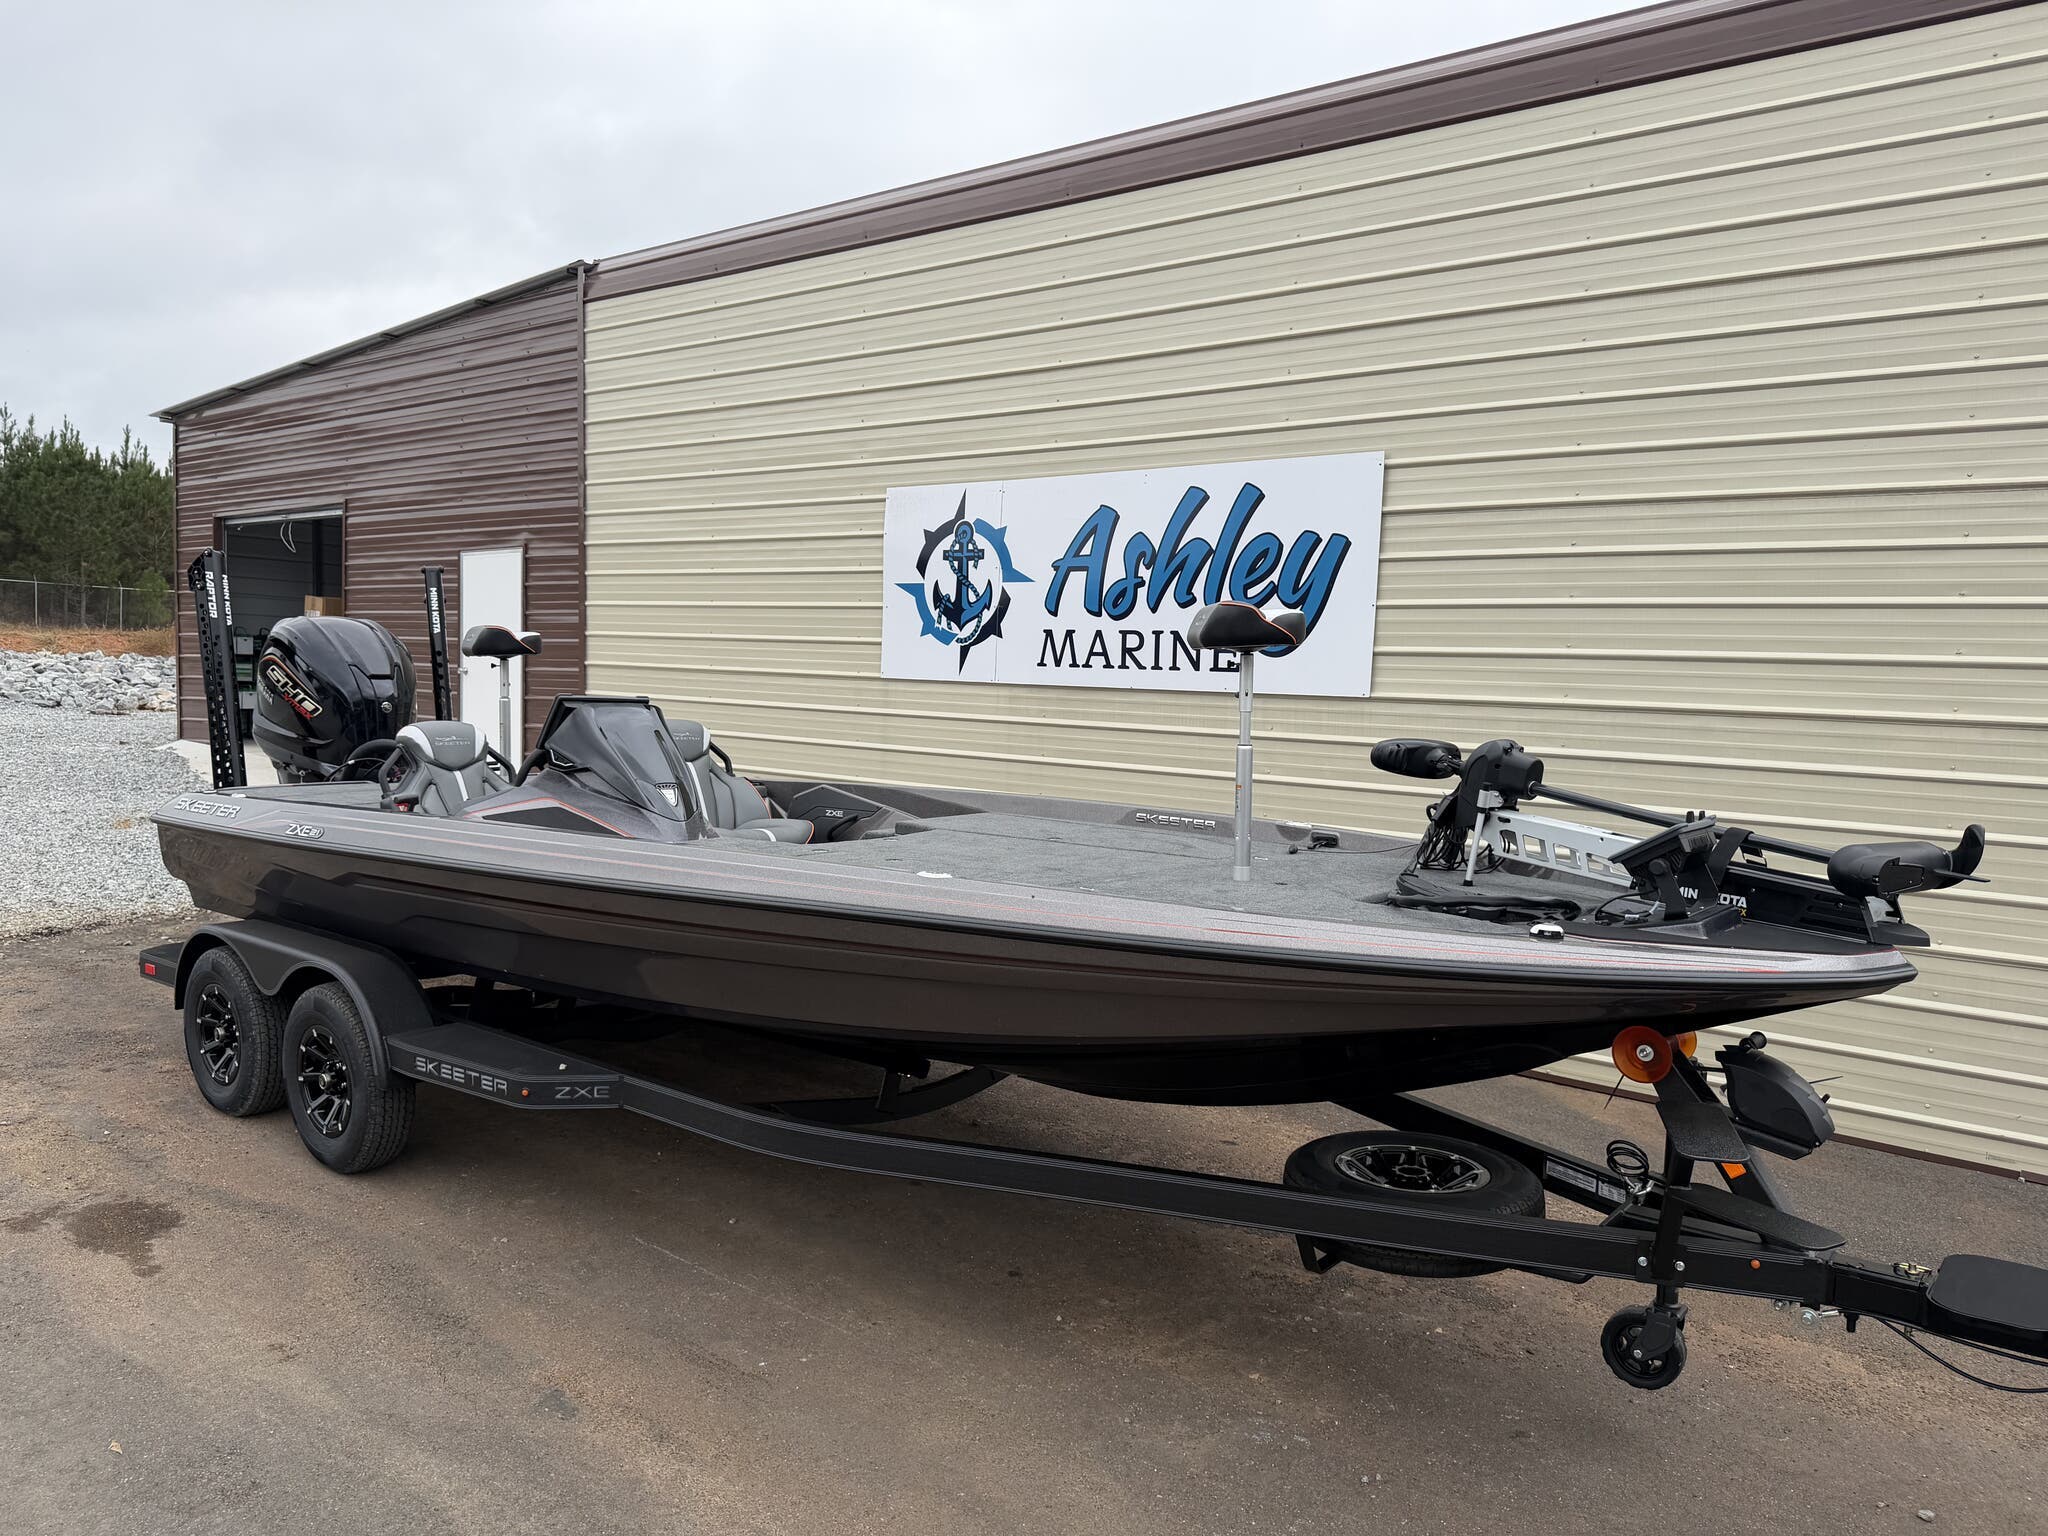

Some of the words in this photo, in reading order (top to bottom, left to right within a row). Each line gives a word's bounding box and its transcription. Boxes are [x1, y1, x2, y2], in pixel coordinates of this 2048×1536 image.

[1044, 482, 1352, 658] Ashley
[205, 571, 218, 618] RAPTOR
[222, 574, 230, 600] MINN
[430, 587, 439, 610] MINN
[224, 601, 233, 626] KOTA
[431, 611, 441, 634] KOTA
[1036, 629, 1240, 672] MARINE
[174, 798, 242, 819] SKEETER
[825, 809, 844, 818] ZXE
[1135, 812, 1216, 829] SKEETER
[1717, 892, 1747, 909] OTA
[415, 1056, 509, 1096] SKEETER
[554, 1085, 611, 1100] ZXE
